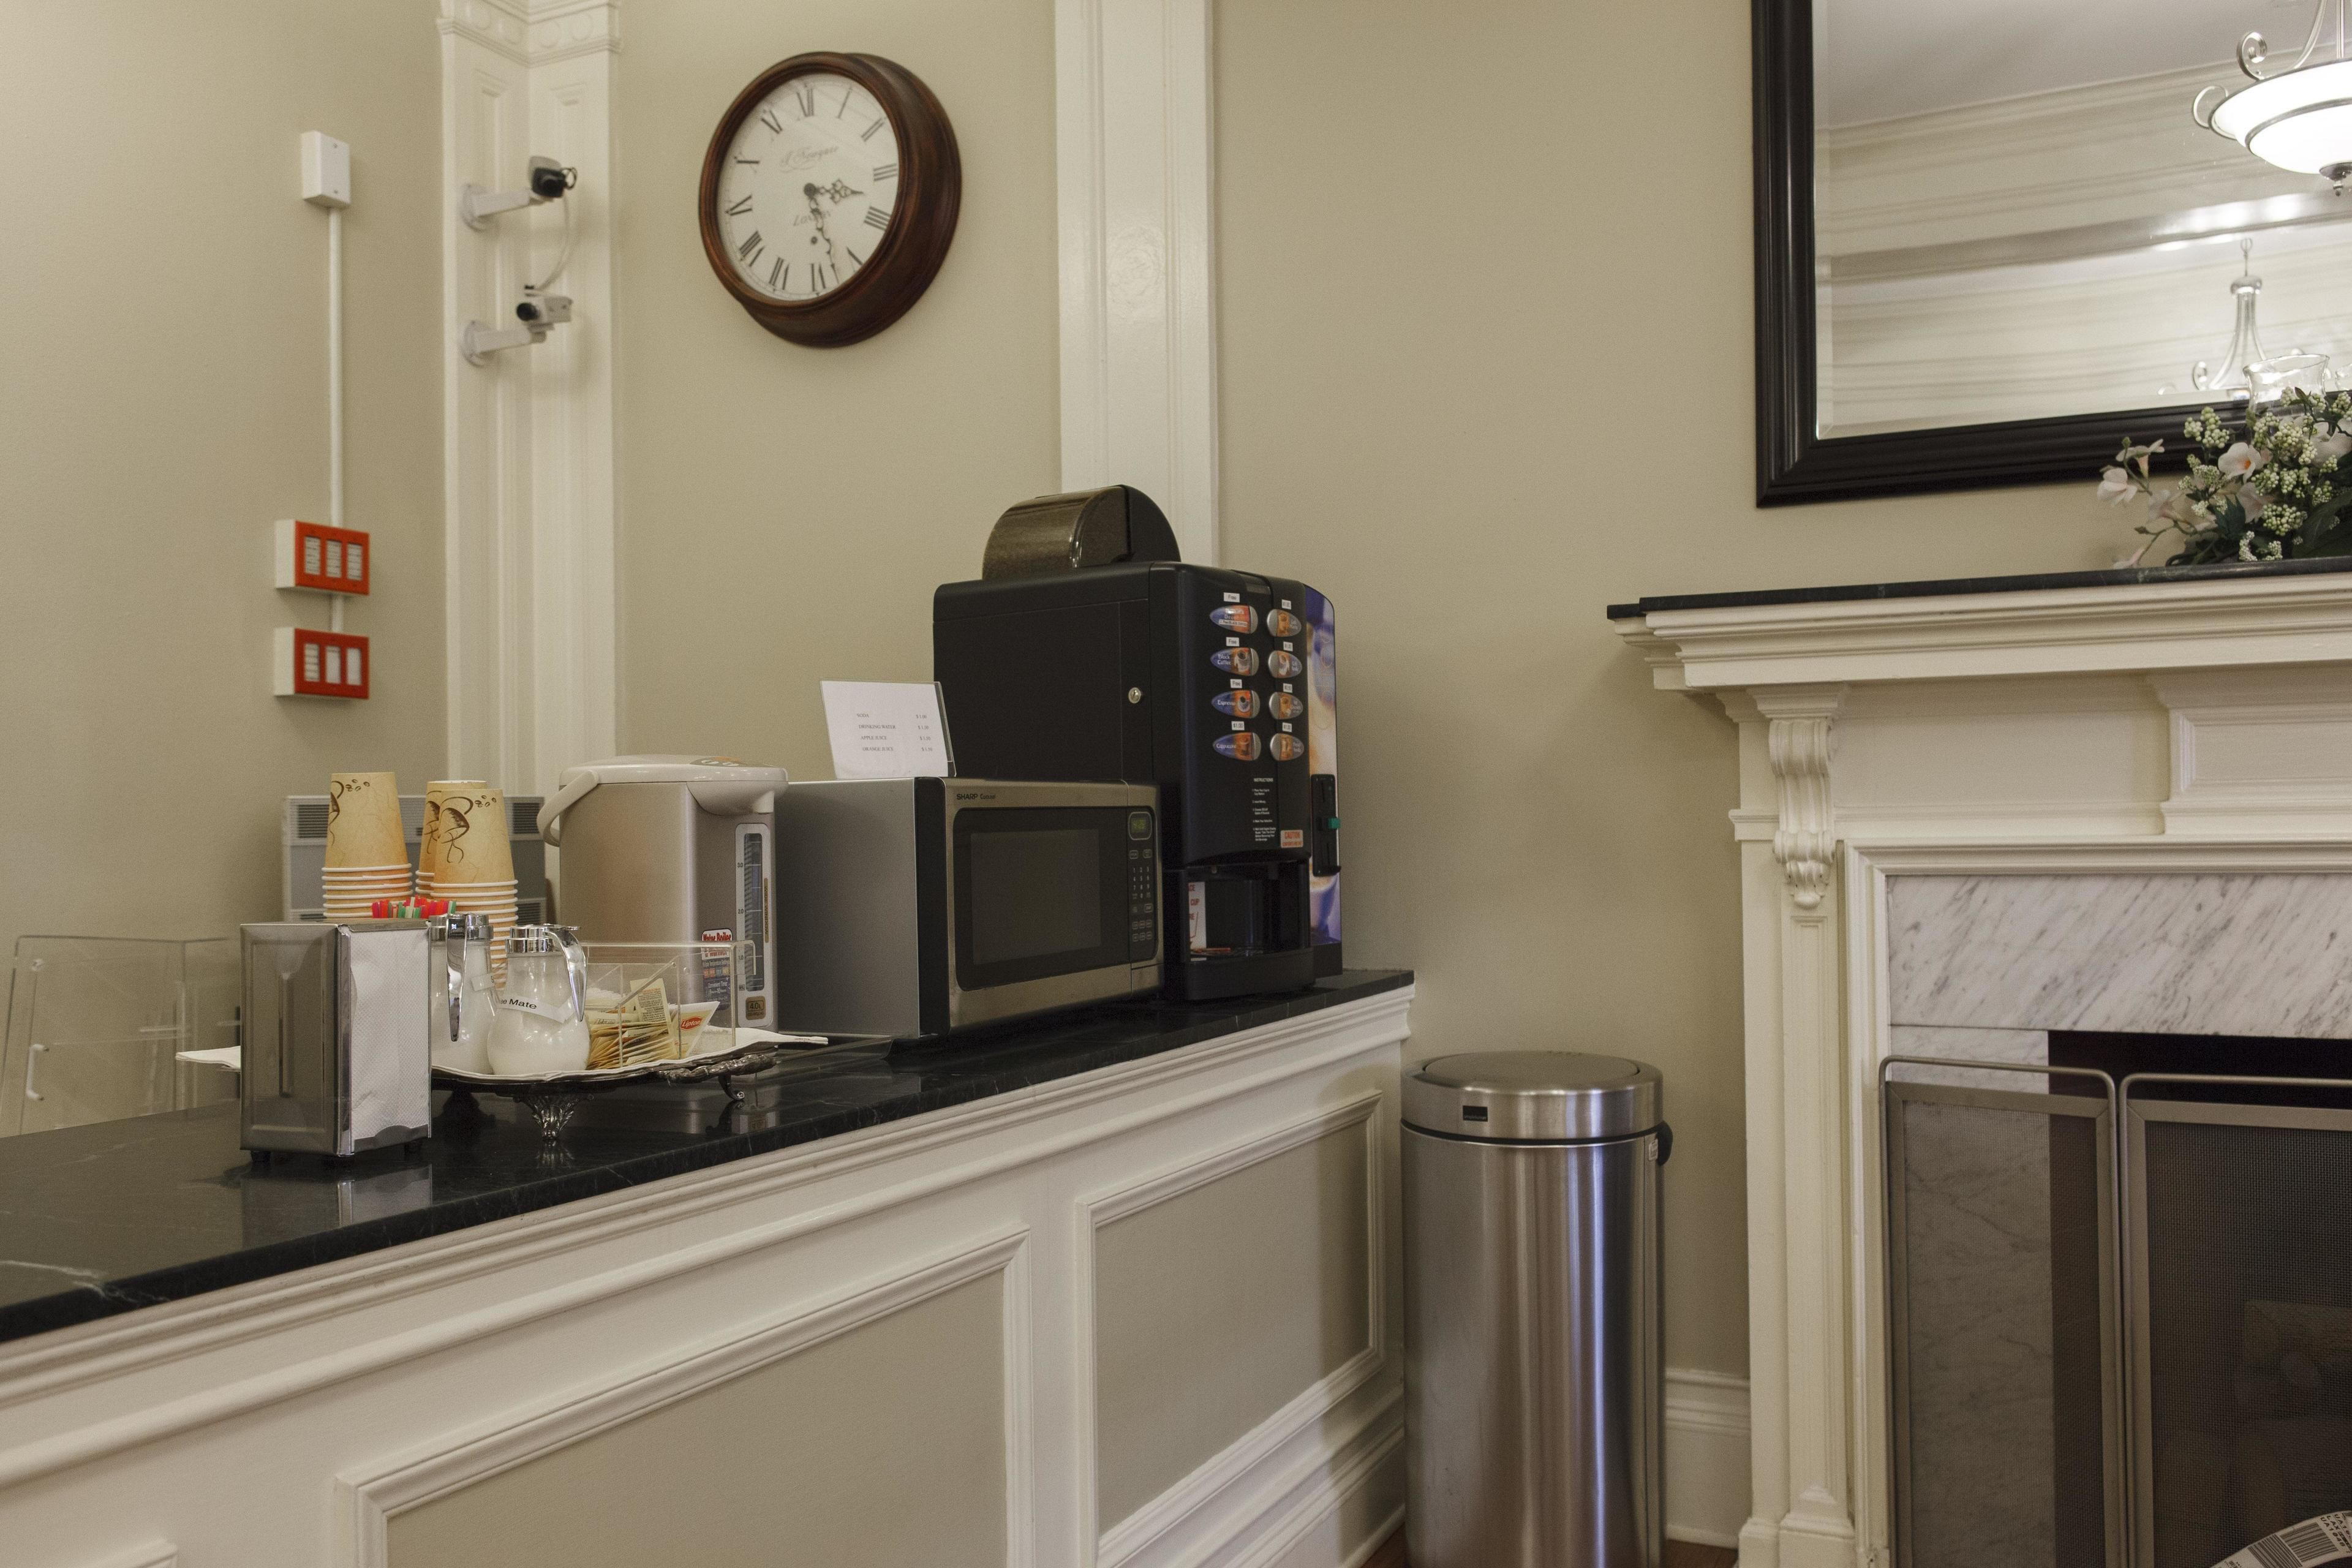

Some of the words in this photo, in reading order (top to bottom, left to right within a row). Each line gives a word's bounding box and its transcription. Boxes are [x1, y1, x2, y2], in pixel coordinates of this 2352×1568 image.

[508, 998, 537, 1009] Mate
[682, 1019, 701, 1028] Lipton
[2326, 1515, 2340, 1530] LAX
